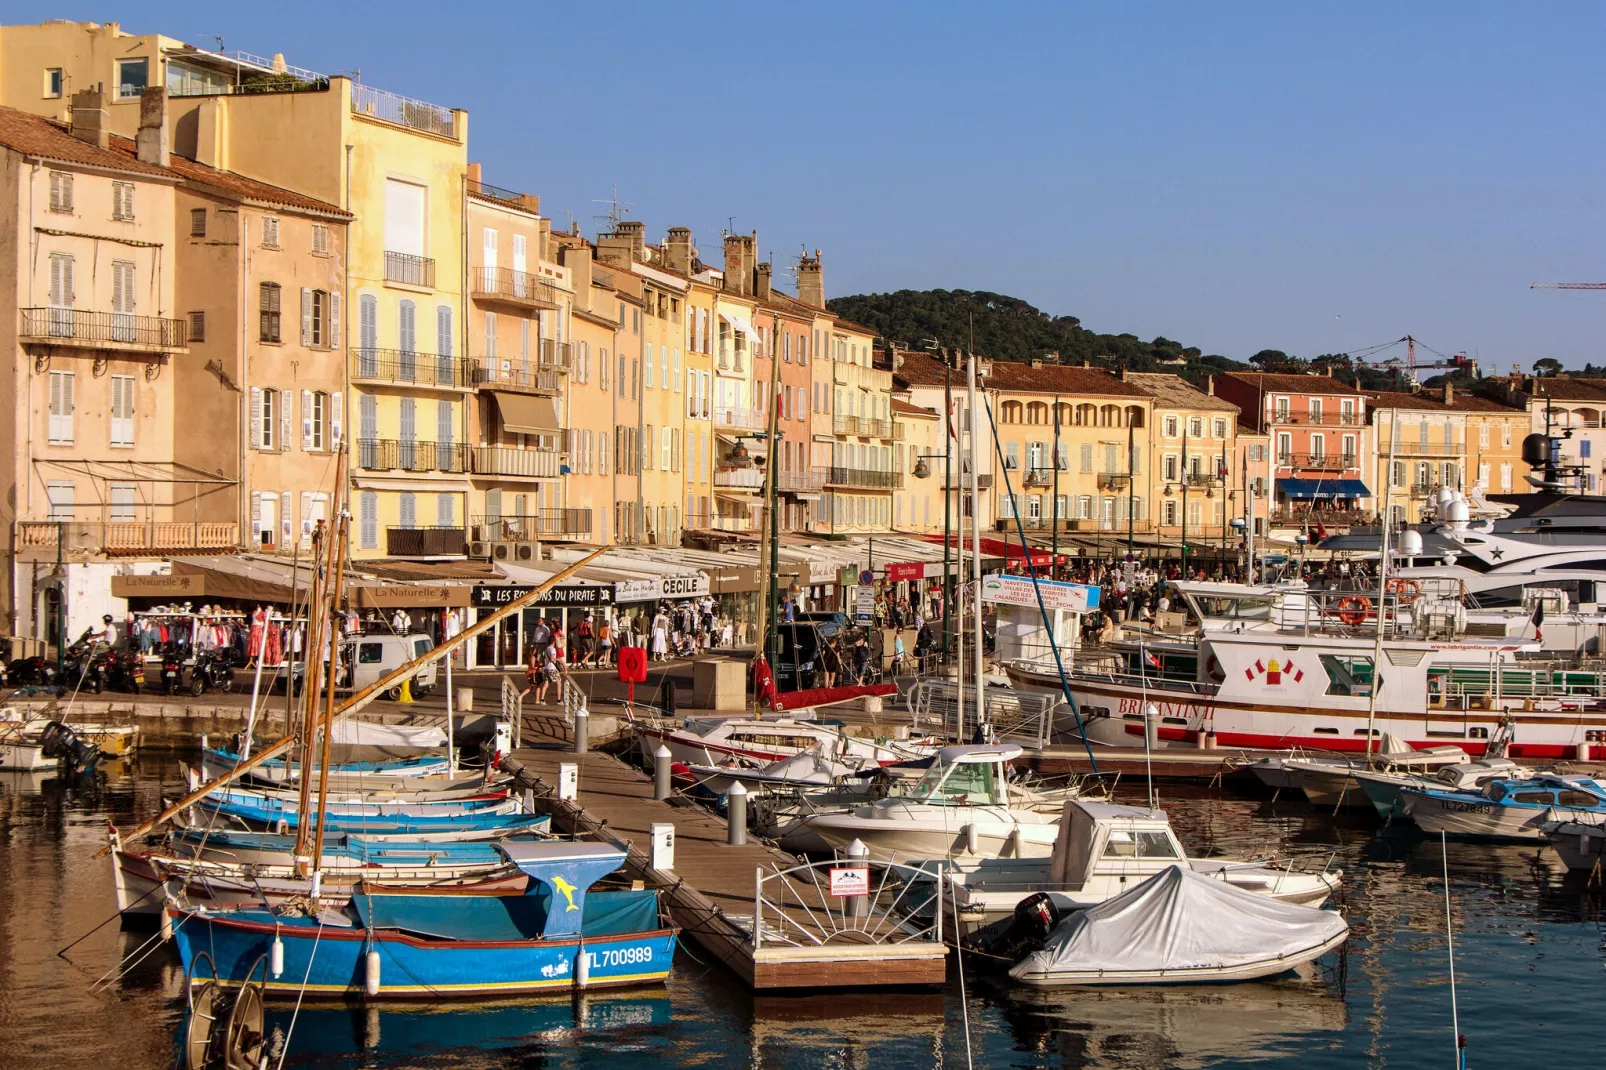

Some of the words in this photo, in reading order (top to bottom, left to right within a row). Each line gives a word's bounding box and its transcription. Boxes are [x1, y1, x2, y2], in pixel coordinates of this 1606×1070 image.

[126, 577, 136, 586] La
[139, 577, 176, 586] Naturelle
[663, 578, 698, 594] CECILE
[1004, 580, 1033, 588] NAVETTES
[375, 588, 387, 597] La
[390, 588, 436, 597] Naturelle
[496, 590, 511, 601] LES
[554, 590, 566, 601] DU
[569, 590, 595, 601] PIRATE
[994, 593, 1028, 602] CALANQUES
[1119, 698, 1199, 718] BRIANTIN
[1203, 706, 1215, 720] II
[1441, 800, 1490, 814] TL727849
[586, 946, 653, 969] TL700989
